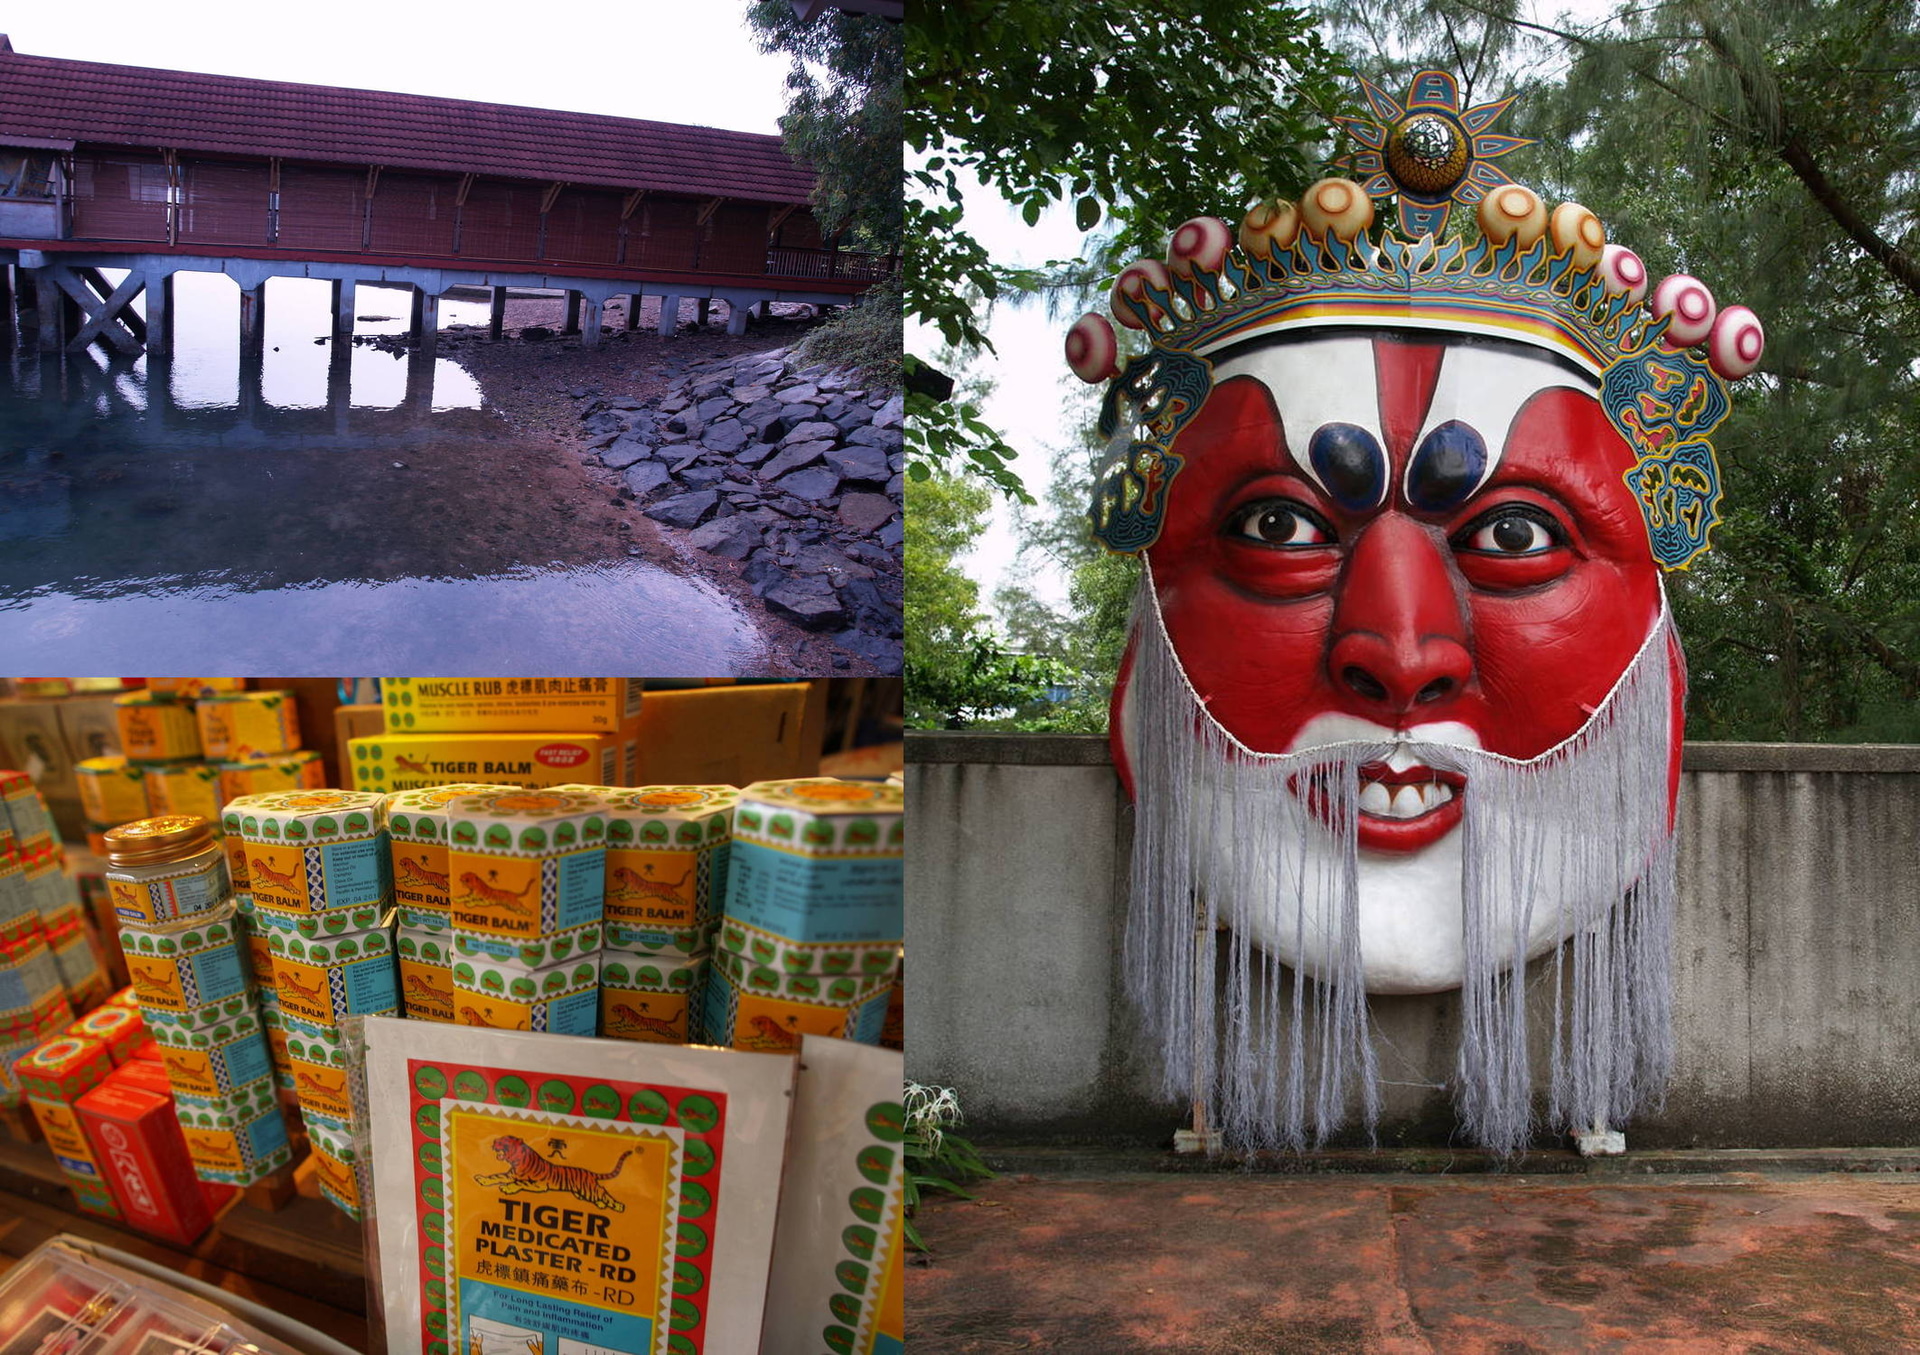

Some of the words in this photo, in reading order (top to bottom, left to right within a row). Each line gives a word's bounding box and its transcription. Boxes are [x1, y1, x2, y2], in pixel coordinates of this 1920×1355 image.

[418, 682, 471, 697] MUSCLE
[474, 680, 502, 695] RUB
[431, 761, 478, 774] TIGER
[484, 761, 532, 774] BALM
[233, 880, 252, 889] TIGE
[252, 891, 275, 904] TIGER
[276, 896, 301, 908] BALM
[396, 890, 424, 900] TIGER
[606, 904, 643, 917] TIGER
[647, 908, 685, 920] BALM
[453, 911, 489, 926] TIGER
[492, 917, 530, 932] BALM
[156, 997, 179, 1007] BALM
[278, 998, 300, 1012] TIGER
[300, 1004, 326, 1019] BALM
[404, 1002, 430, 1015] TIGER
[321, 1101, 348, 1114] BALM
[498, 1198, 611, 1239] TIGER
[480, 1220, 631, 1263] MEDICATED
[475, 1258, 589, 1298] 虎標鎮痛藥布
[493, 1290, 509, 1301] For
[510, 1294, 534, 1308] Long
[536, 1300, 572, 1316] Lasting
[573, 1308, 601, 1323] Relief
[603, 1315, 613, 1324] of
[501, 1301, 521, 1313] Pain
[523, 1306, 541, 1317] and
[542, 1311, 604, 1332] Inflammation
